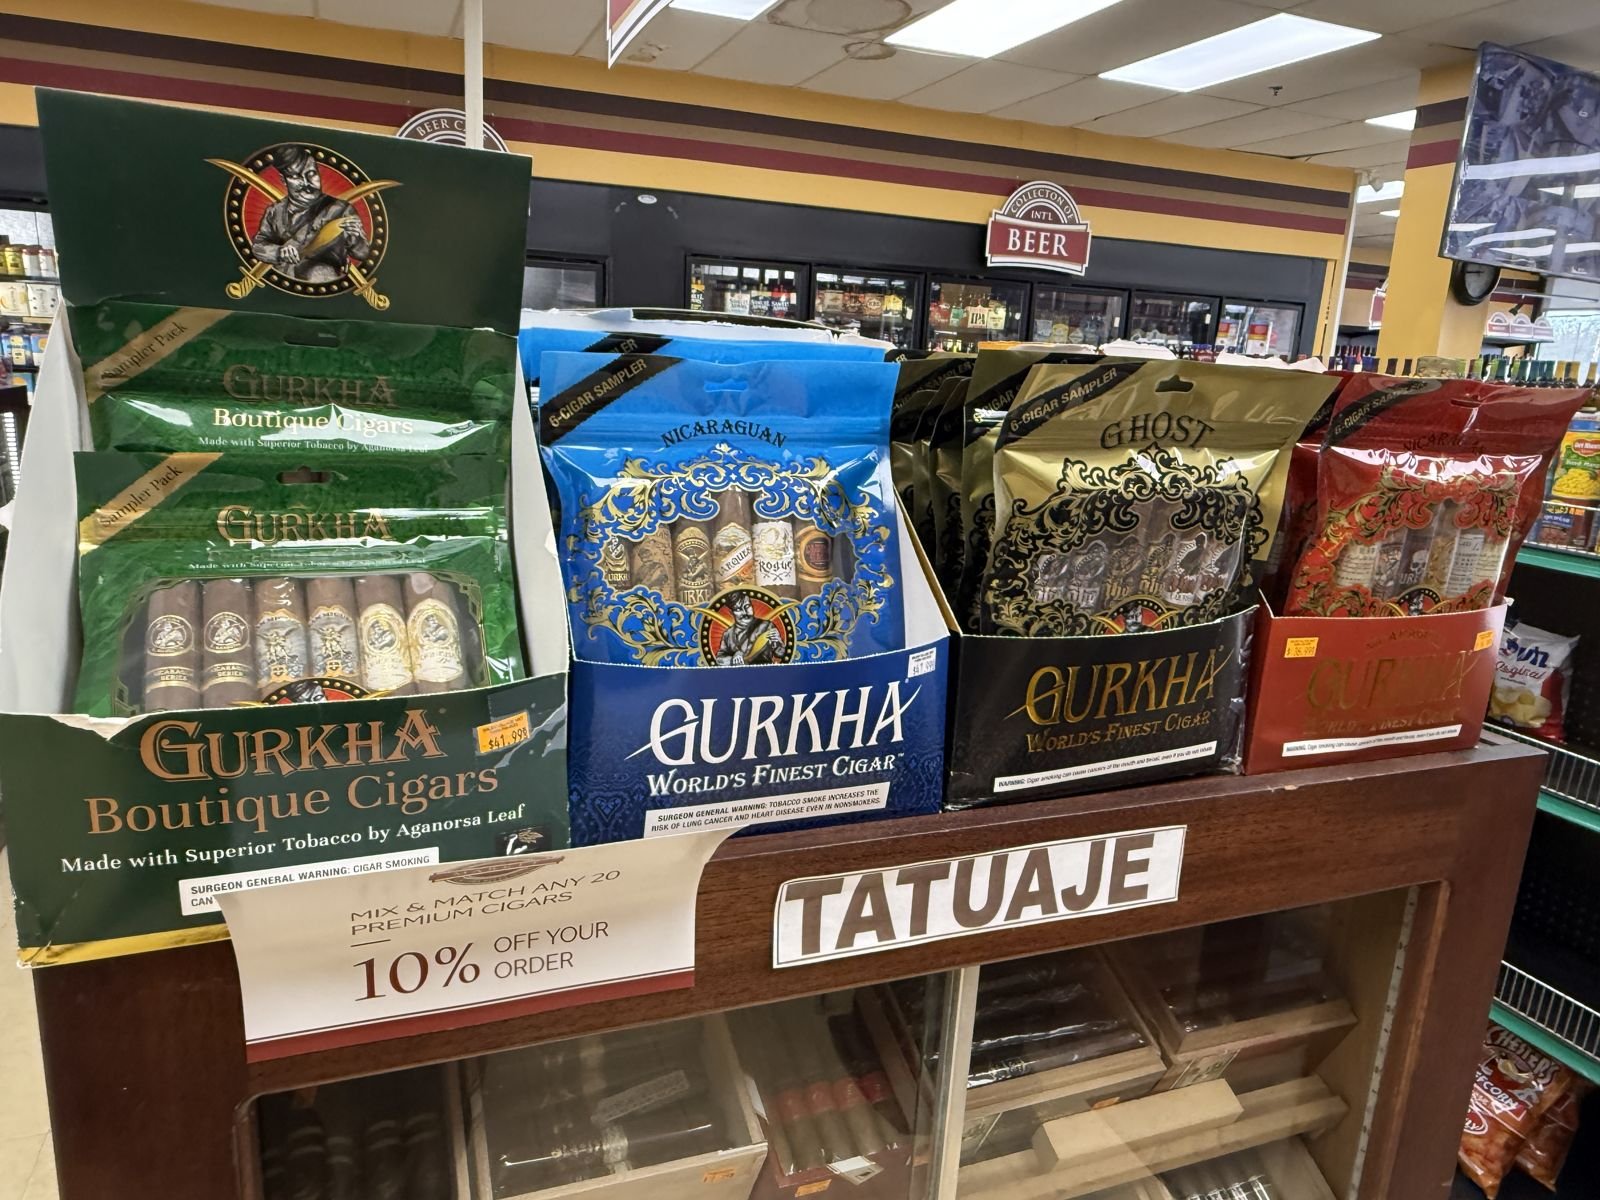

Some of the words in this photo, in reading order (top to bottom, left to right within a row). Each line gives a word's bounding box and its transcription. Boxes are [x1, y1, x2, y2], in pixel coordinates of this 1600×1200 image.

[416, 118, 450, 137] BEER
[1063, 204, 1075, 220] OF
[1007, 227, 1068, 257] BEER
[153, 321, 188, 347] Pack
[970, 313, 985, 325] IPA
[222, 364, 398, 408] GURKHA
[549, 389, 595, 428] 6-CIGAR
[594, 357, 648, 398] SAMPLER
[1010, 398, 1059, 432] 6-CIGAR
[1060, 366, 1119, 405] SAMPLER
[212, 408, 330, 435] Boutique
[335, 412, 414, 438] Cigars
[659, 418, 789, 449] NICARAGUAN
[1100, 411, 1217, 451] GHOST
[199, 436, 229, 447] Made
[229, 437, 255, 448] with
[257, 439, 302, 452] Superior
[304, 440, 344, 451] Tobacco
[347, 441, 359, 453] by
[100, 487, 151, 528] Sampler
[150, 465, 183, 492] Pack
[216, 504, 397, 545] GURKHA
[756, 557, 793, 575] Rogue
[1004, 649, 1234, 725] GURKHA
[625, 680, 921, 766] GURKHA
[1026, 728, 1101, 753] WORLD'S
[1103, 719, 1162, 744] FINEST
[139, 709, 447, 782] GURKHA
[646, 767, 747, 797] WORLD'S
[752, 761, 831, 787] FINEST
[831, 753, 895, 776] CIGAR
[85, 789, 331, 835] Boutique
[348, 767, 500, 814] Cigars
[651, 823, 669, 833] RISK
[670, 822, 680, 830] OF
[682, 819, 703, 829] LUNG
[703, 816, 734, 826] CANCER
[734, 813, 750, 822] AND
[751, 810, 774, 820] HEART
[775, 807, 805, 817] DISEASE
[806, 804, 825, 813] EVEN
[824, 803, 833, 811] IN
[658, 811, 695, 823] SURGEON
[695, 806, 729, 818] GENERAL
[731, 802, 768, 814] WARNING:
[769, 798, 801, 809] TOBACCO
[802, 795, 827, 806] SMOKE
[828, 790, 865, 802] INCREASES
[866, 788, 880, 797] THE
[60, 854, 122, 875] Made
[128, 844, 179, 869] with
[185, 838, 277, 870] Superior
[281, 829, 363, 854] Tobacco
[367, 824, 392, 845] by
[396, 812, 483, 844] Aganorsa
[487, 803, 527, 825] Leaf
[190, 880, 244, 896] SURGEON
[245, 873, 296, 888] GENERAL
[297, 867, 351, 881] WARNING:
[352, 861, 384, 873] CIGAR
[385, 855, 431, 869] SMOKING
[350, 906, 399, 923] MIX
[406, 901, 427, 914] &
[434, 885, 526, 909] MATCH
[530, 875, 583, 896] ANY
[588, 869, 621, 885] 20
[785, 833, 1155, 957] TATUAJE
[350, 908, 476, 936] PREMIUM
[480, 891, 574, 916] CIGARS
[493, 931, 541, 954] OFF
[544, 920, 610, 945] YOUR
[352, 943, 482, 1003] 10%
[493, 951, 574, 980] ORDER
